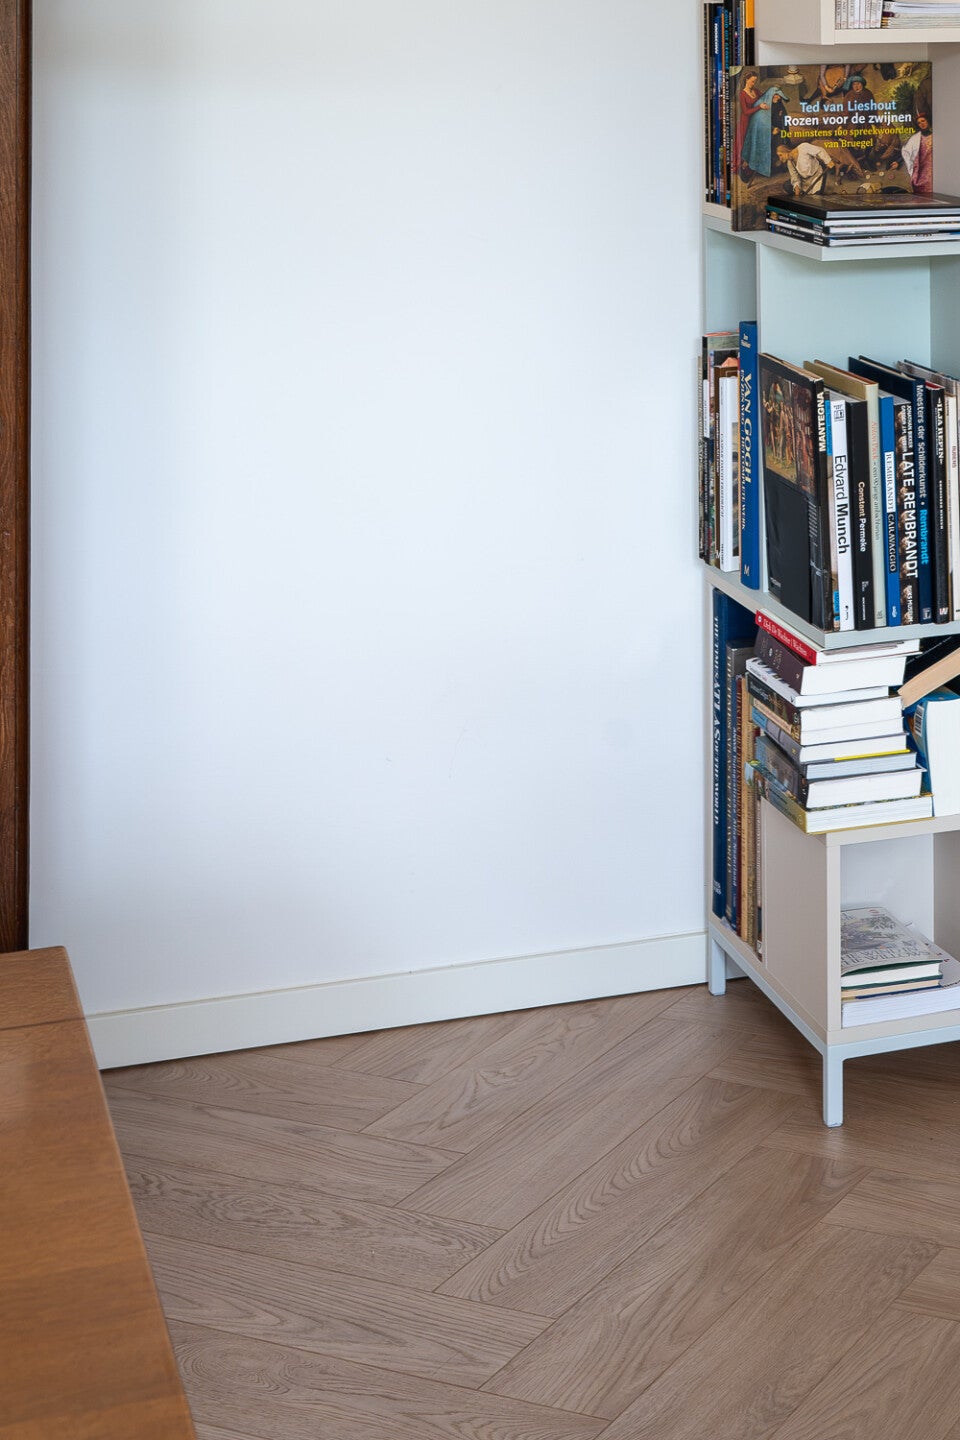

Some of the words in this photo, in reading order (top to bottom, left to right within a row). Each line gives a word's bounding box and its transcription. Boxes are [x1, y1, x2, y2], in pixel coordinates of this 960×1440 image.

[784, 115, 819, 127] Rozen
[822, 115, 848, 125] voor
[851, 112, 866, 124] de
[868, 111, 912, 126] zwijnen
[799, 100, 820, 113] Ted
[823, 102, 844, 112] van
[847, 99, 897, 112] Lieshout
[780, 130, 792, 139] De
[793, 130, 833, 139] minstens
[834, 126, 848, 137] 160
[849, 125, 914, 138] spreekwoorden
[840, 138, 874, 150] Bruegel
[744, 373, 752, 412] VAN
[915, 385, 924, 424] Meesters
[817, 391, 826, 452] MANTEGNA
[917, 425, 925, 440] der
[744, 418, 753, 484] GOGH
[902, 452, 915, 487] LATE
[917, 441, 927, 499] Schilderkunst
[834, 454, 848, 501] Edvard
[857, 481, 865, 517] Constant
[885, 453, 894, 512] REMBRANDT
[836, 503, 850, 555] Munch
[859, 518, 867, 552] Permeke
[887, 512, 897, 572] CARAVAGGIO
[904, 491, 918, 579] REMBRANDT
[919, 509, 930, 565] Rembrandt
[713, 678, 721, 740] ATLAS
